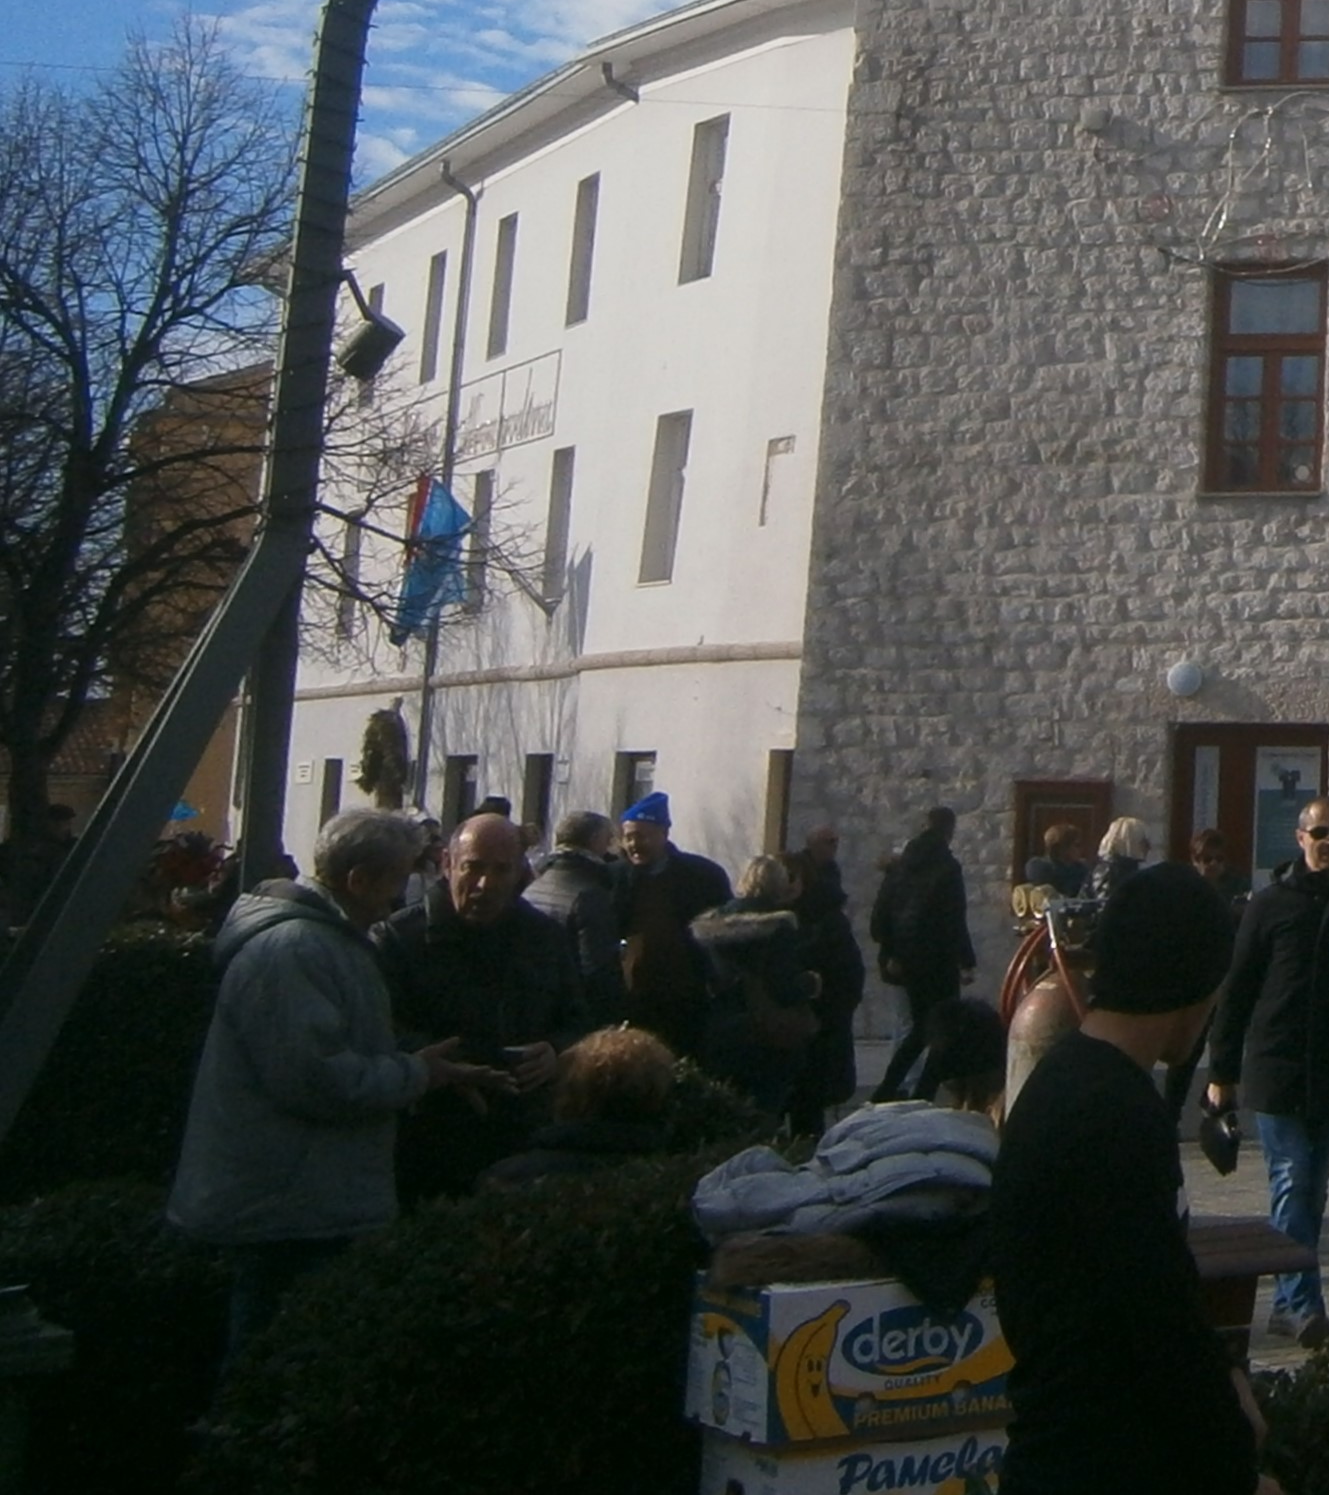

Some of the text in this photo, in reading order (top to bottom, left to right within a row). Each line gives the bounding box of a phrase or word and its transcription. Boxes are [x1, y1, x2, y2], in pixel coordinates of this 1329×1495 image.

[852, 1311, 973, 1366] derby
[884, 1375, 941, 1390] QUALITY
[853, 1401, 949, 1429] PREMIUM
